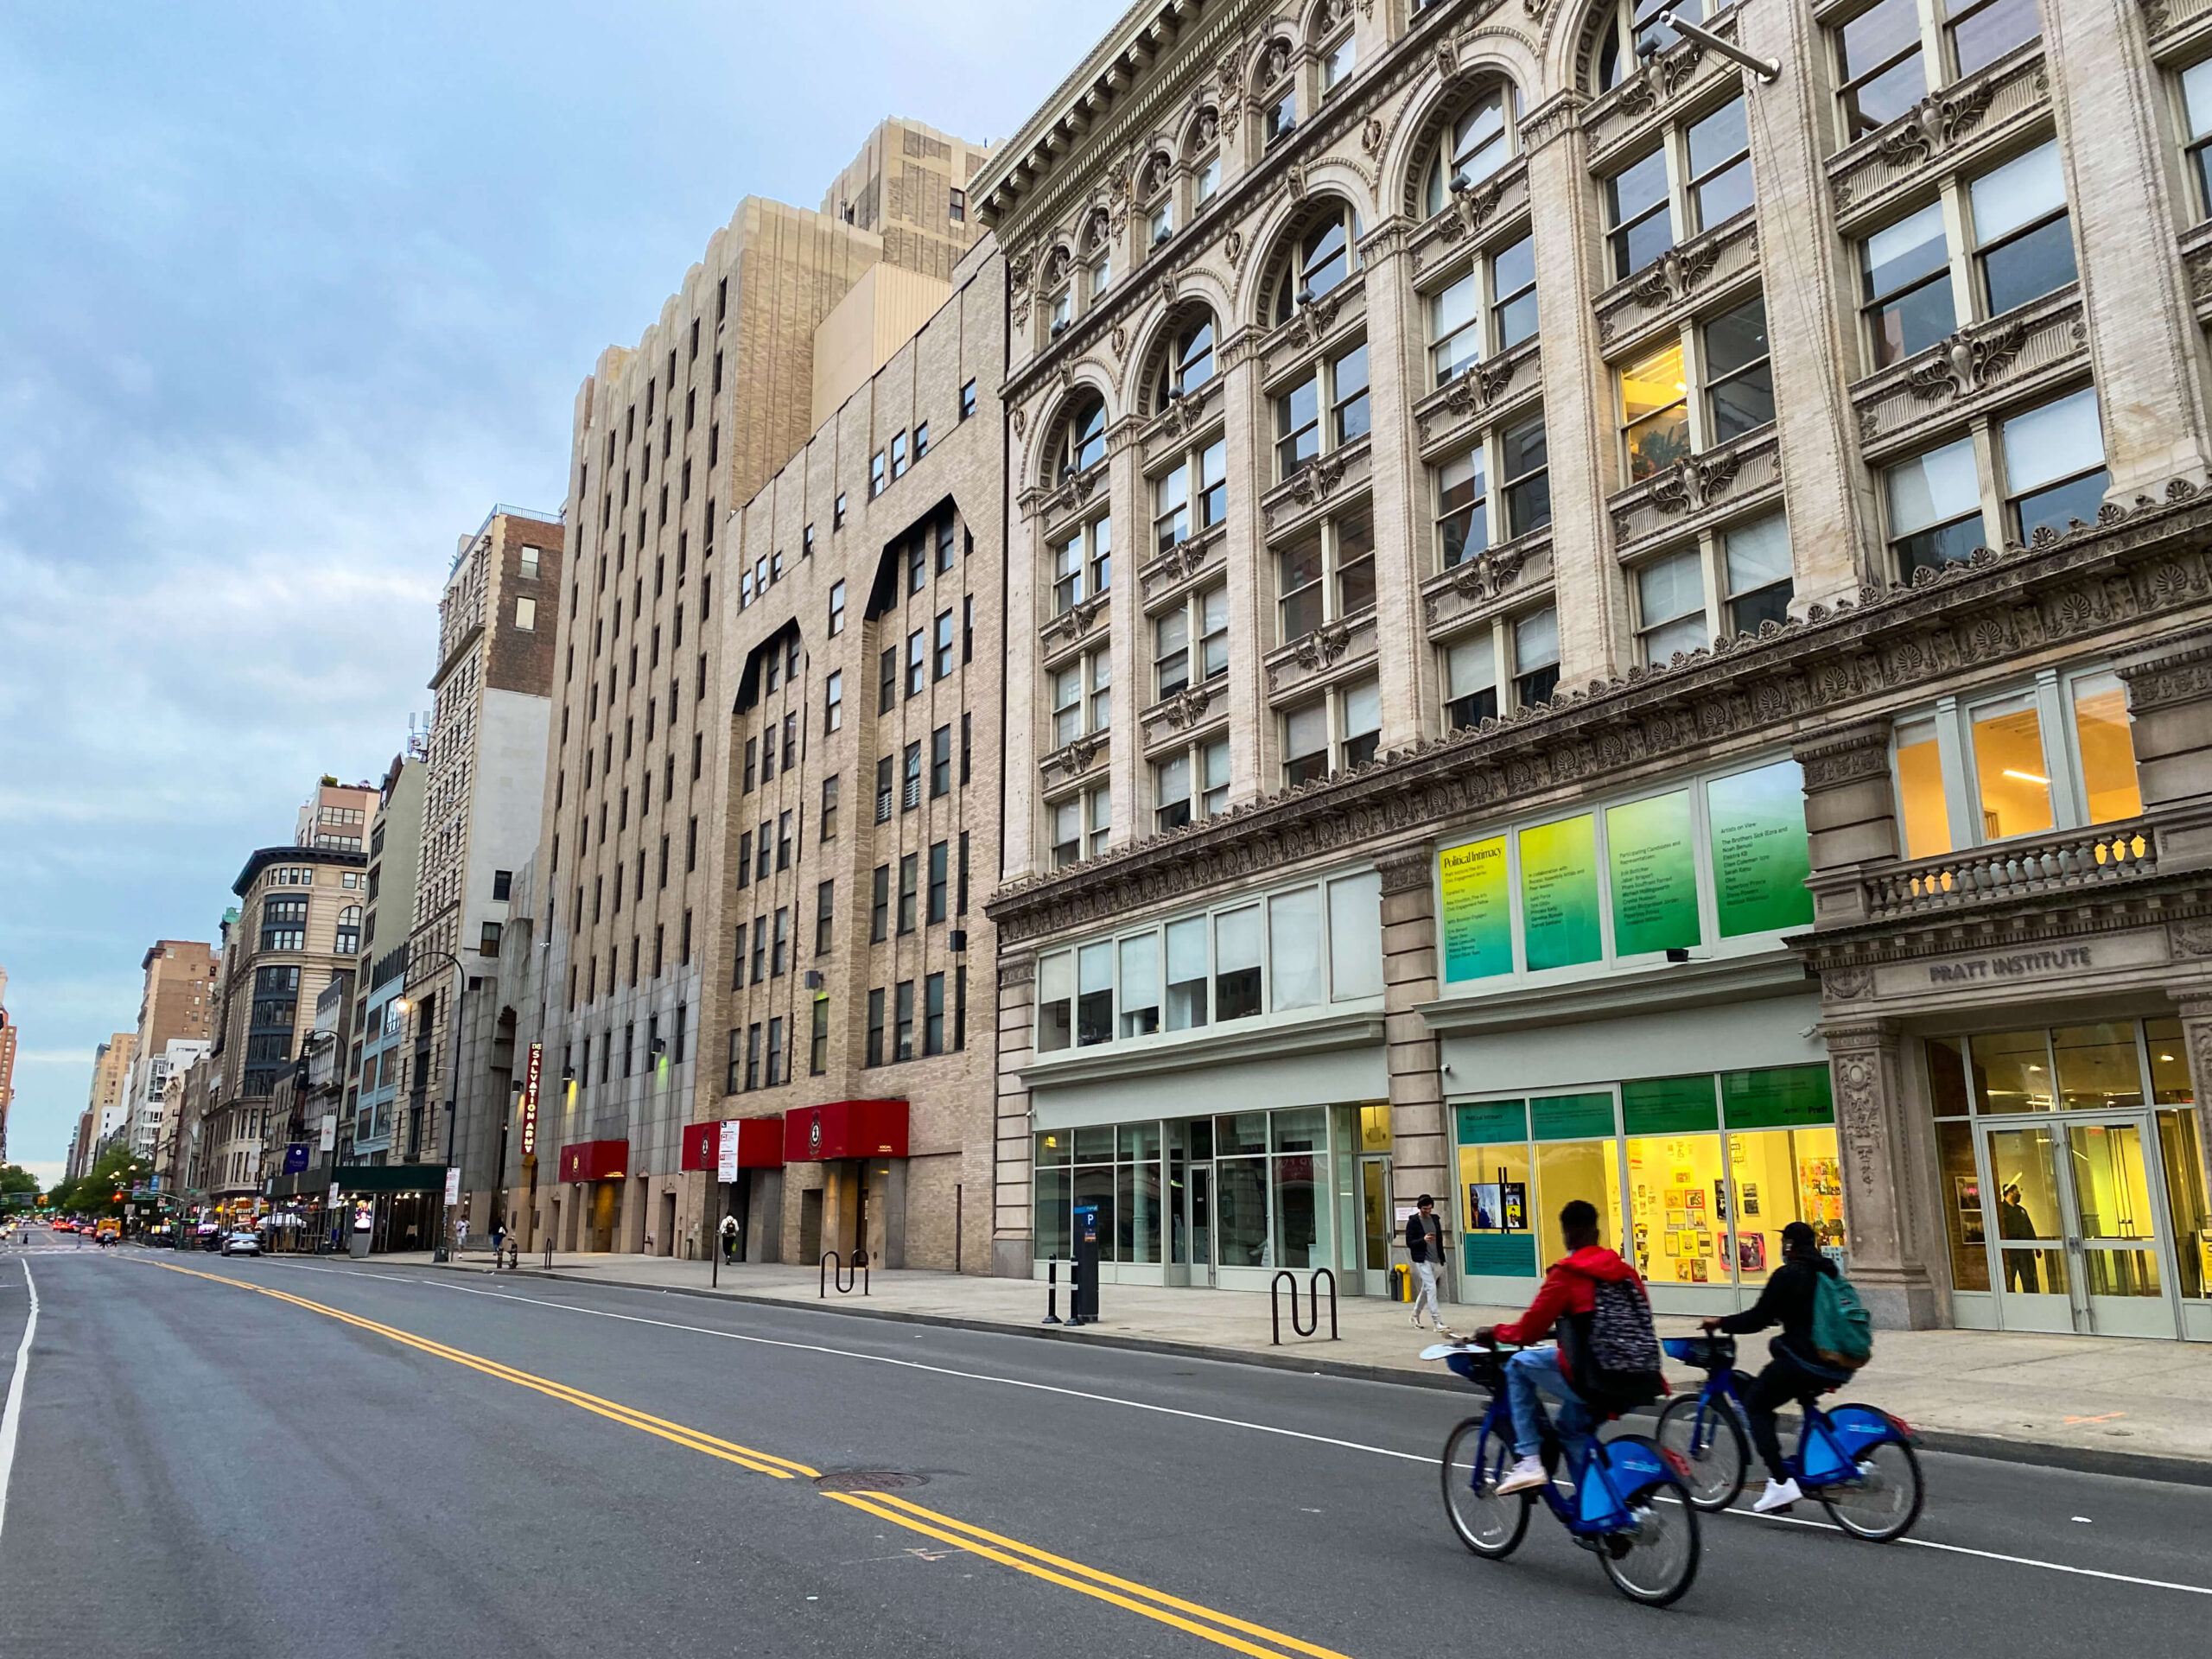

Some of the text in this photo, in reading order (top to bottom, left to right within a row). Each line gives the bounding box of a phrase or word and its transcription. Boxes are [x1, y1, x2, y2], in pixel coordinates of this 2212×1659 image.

[1731, 835, 1752, 843] Brothers
[1444, 848, 1502, 868] Political Intimacy
[1619, 849, 1647, 858] Participating
[1647, 842, 1672, 853] Candidates
[1533, 868, 1559, 877] collaboration
[1929, 946, 2091, 982] PRATT INSTITUTE
[526, 1050, 540, 1120] SALVATION
[524, 1122, 534, 1154] ARMY
[1088, 1213, 1094, 1225] P
